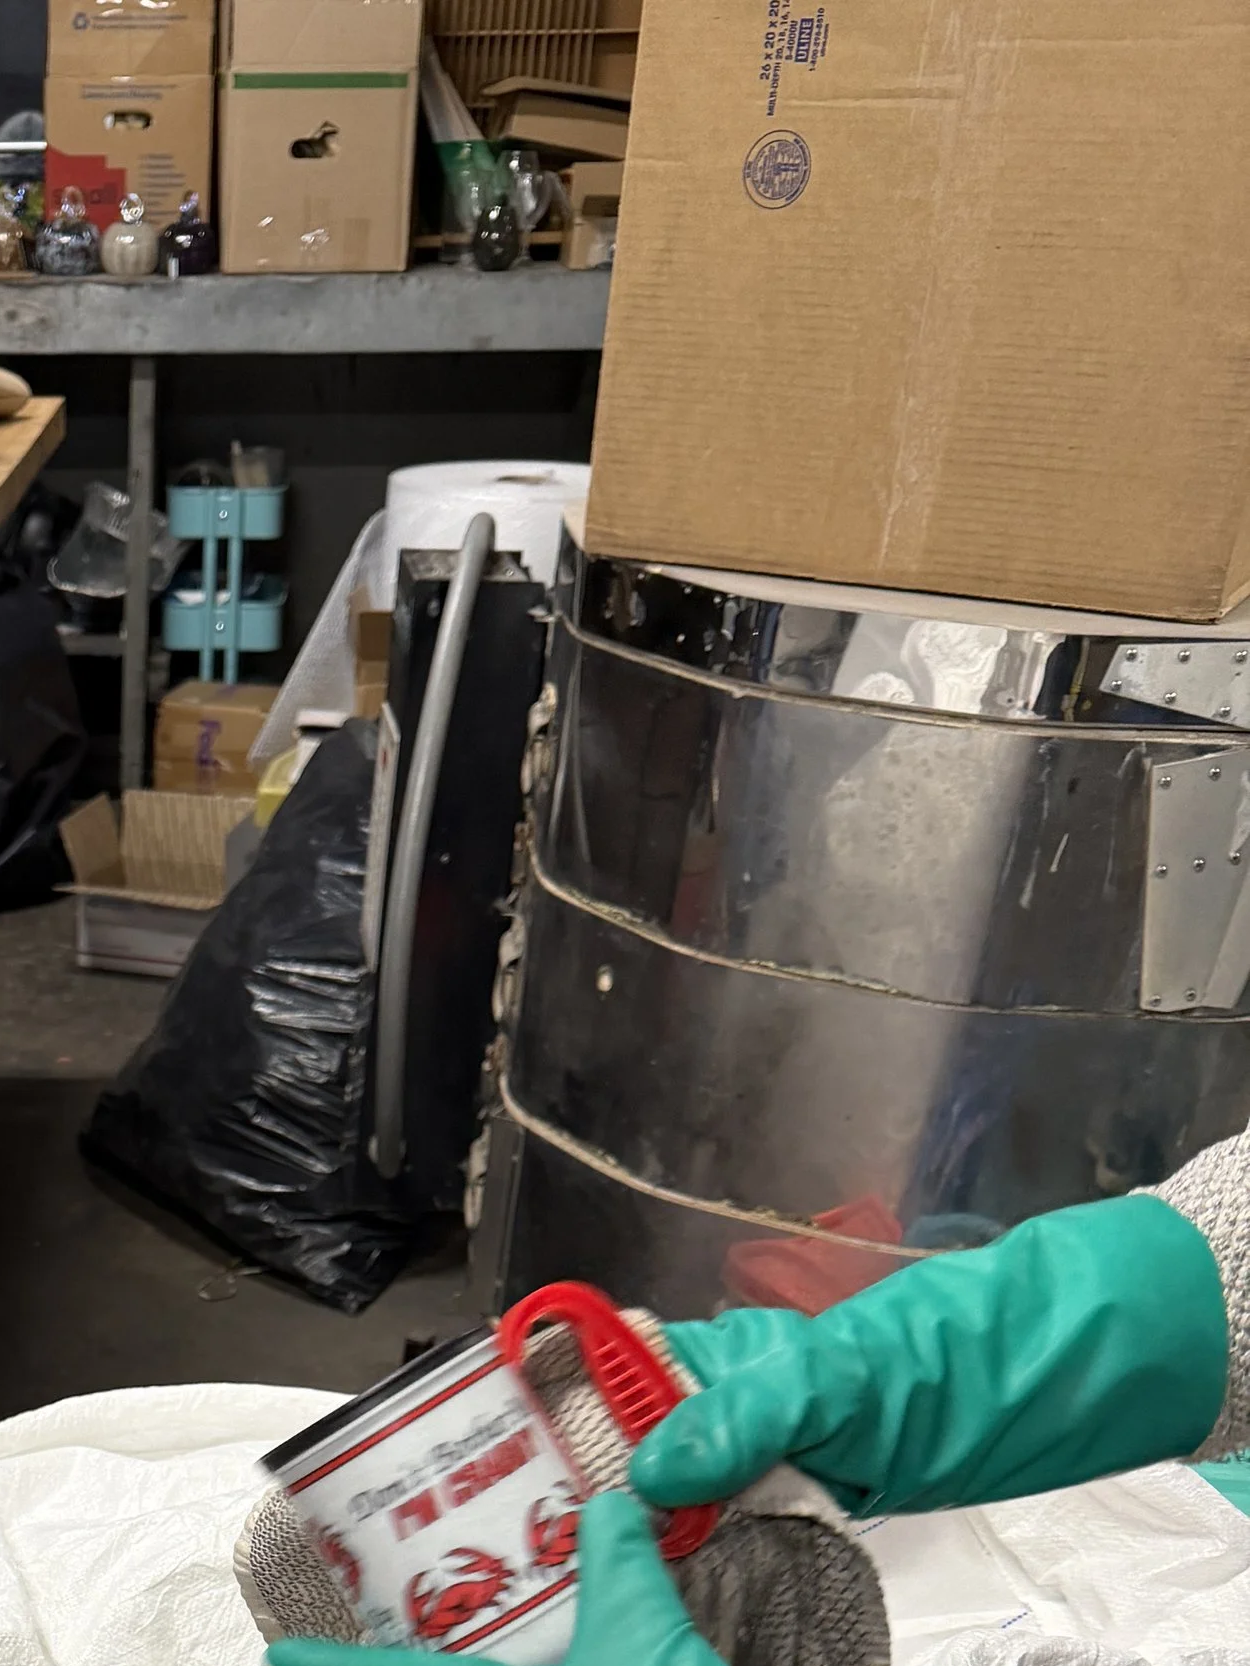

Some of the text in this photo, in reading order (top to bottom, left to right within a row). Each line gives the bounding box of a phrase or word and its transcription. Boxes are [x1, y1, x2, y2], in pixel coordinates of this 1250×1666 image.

[768, 0, 780, 17] 20
[764, 32, 776, 49] 20
[796, 19, 813, 61] ULINE
[760, 63, 772, 81] 26
